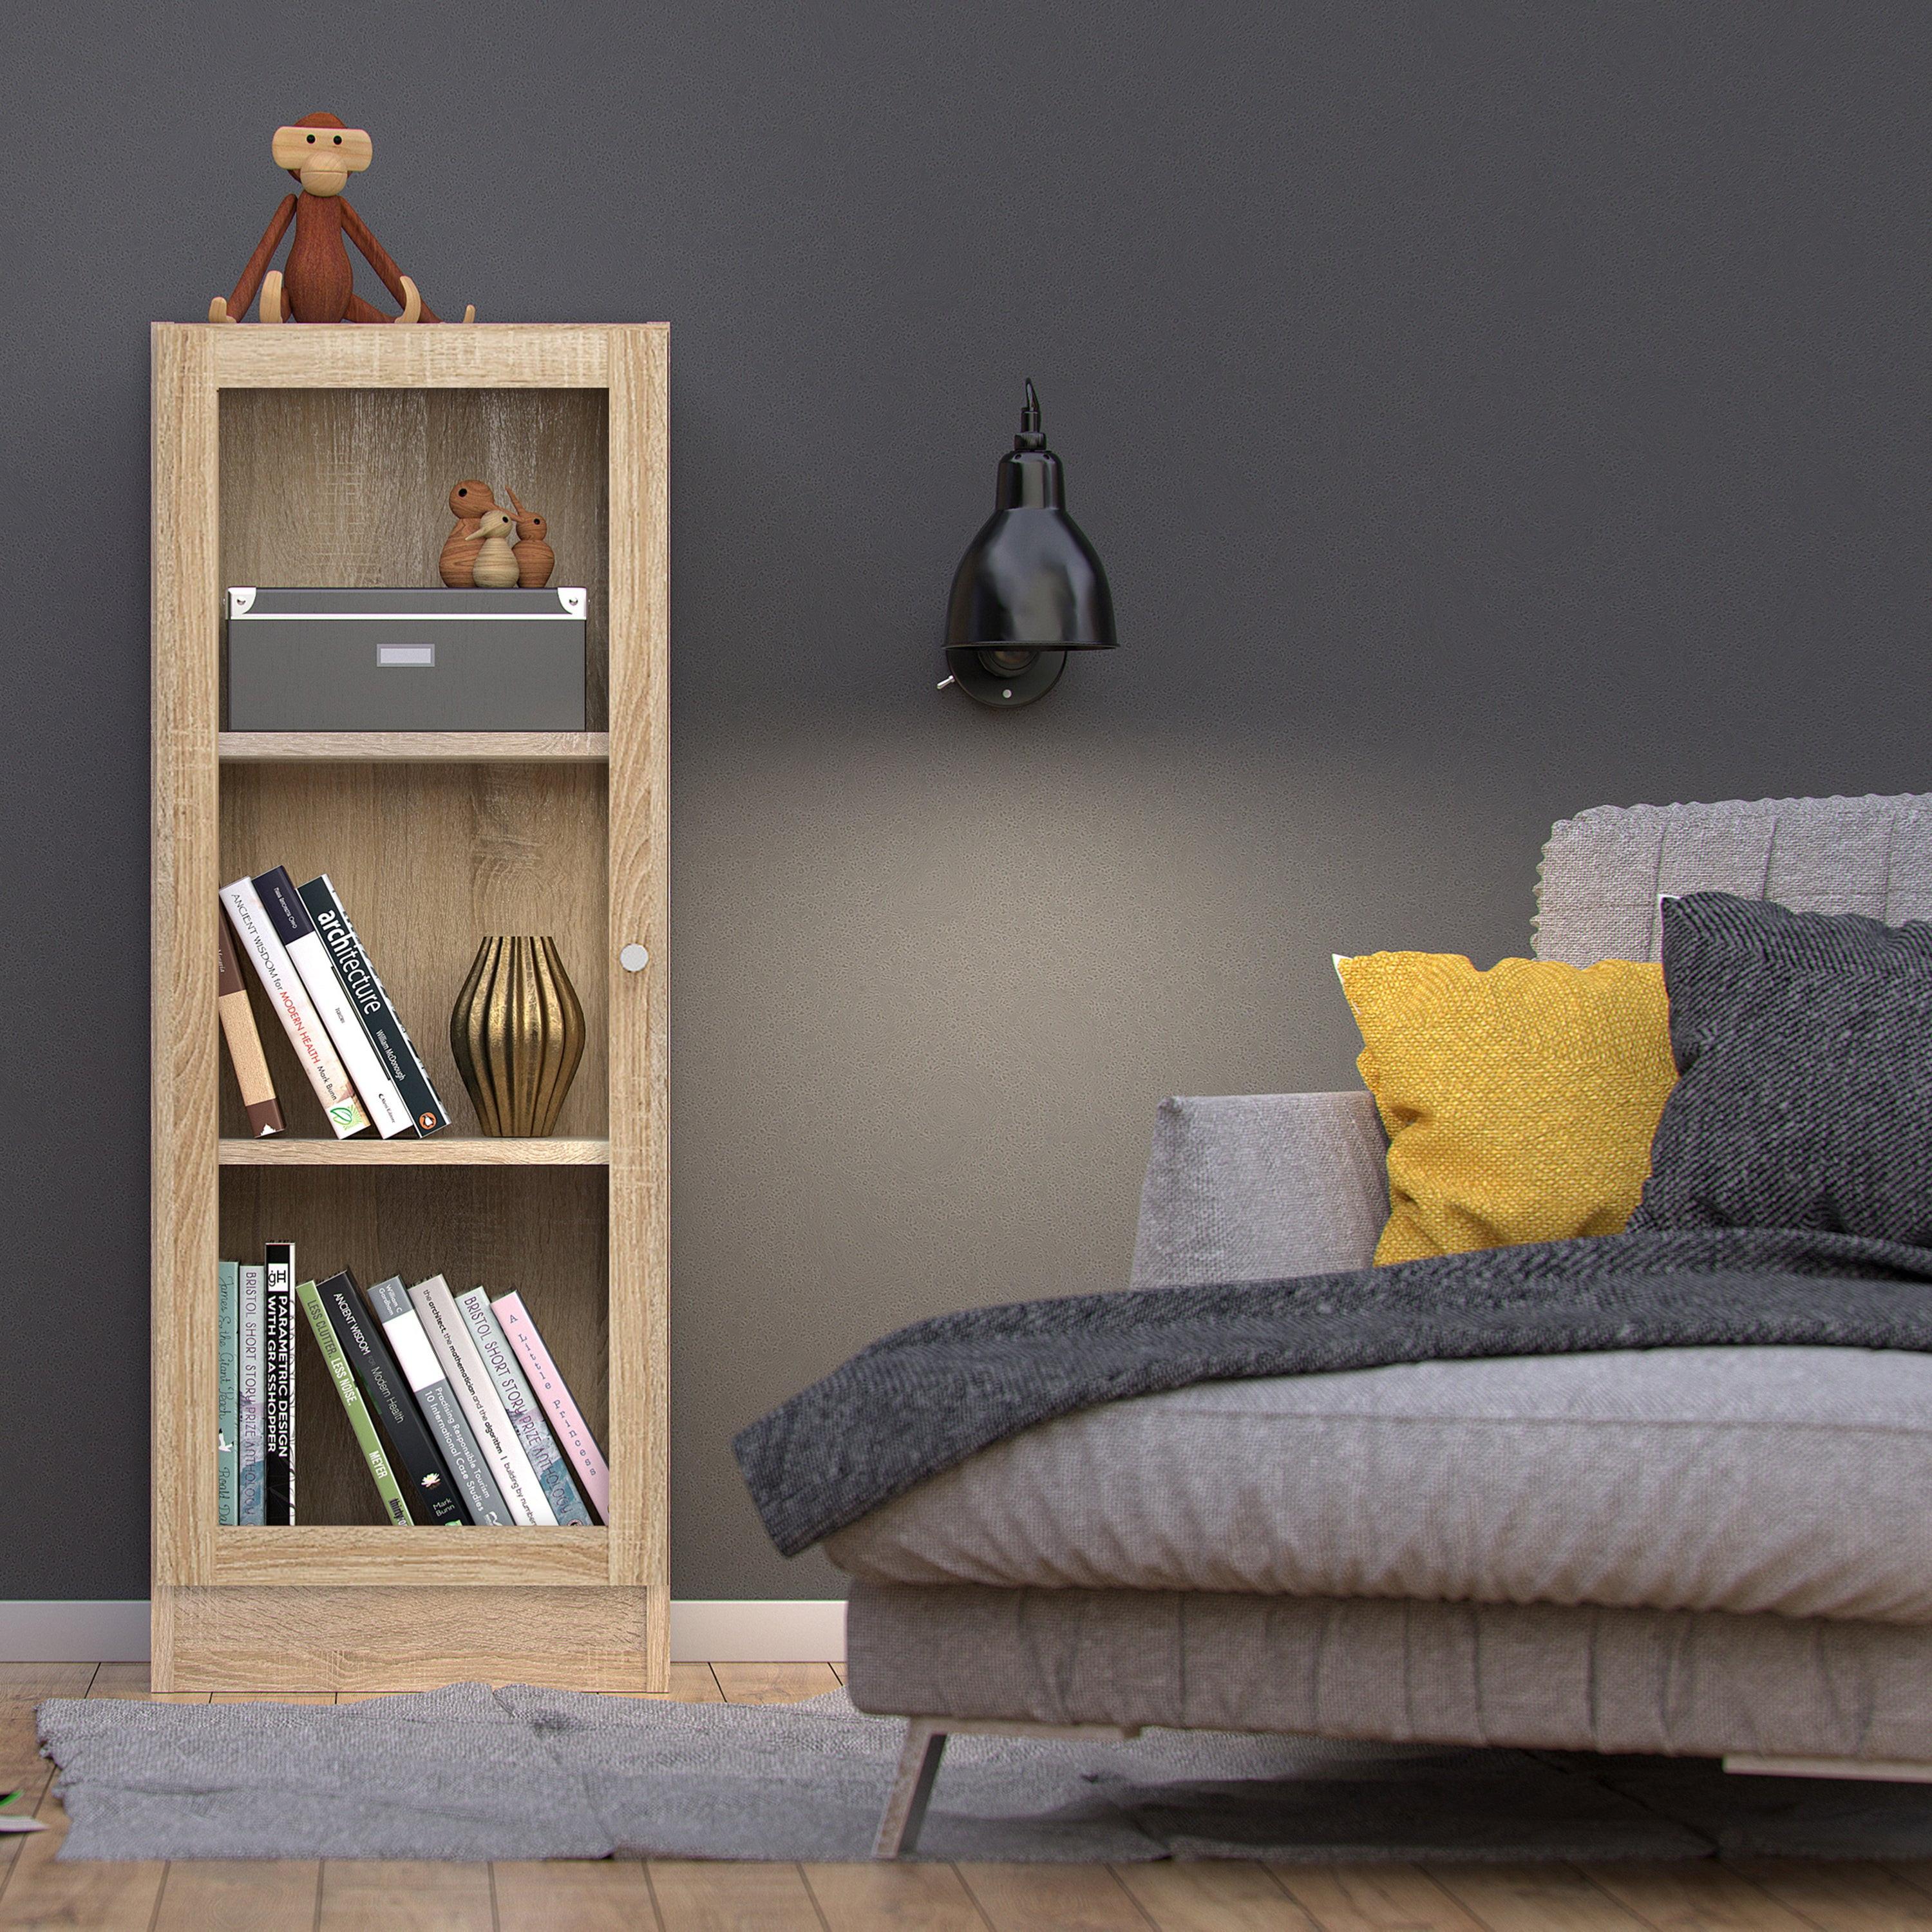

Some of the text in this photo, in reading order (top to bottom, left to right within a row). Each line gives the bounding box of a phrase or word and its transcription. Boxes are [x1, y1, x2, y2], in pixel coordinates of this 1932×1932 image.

[317, 909, 381, 1015] architecture
[231, 893, 337, 1101] ANCIENT WISDOM for MODERN HEALTH Mark Bunn
[375, 1029, 389, 1050] William
[386, 1048, 406, 1081] McDonough
[245, 1272, 256, 1318] BRISTOL
[379, 1288, 394, 1316] Gardham
[386, 1283, 399, 1307] William
[220, 1329, 231, 1347] the
[245, 1322, 256, 1360] SHORT
[307, 1300, 357, 1406] LESS CLUTTER. LESS NOISE.
[334, 1293, 404, 1424] ANCIENT WISDOM FOR Modern Health
[219, 1353, 234, 1383] Giant
[245, 1365, 256, 1405] STORY
[268, 1295, 276, 1452] WITH GRASSHOPPER
[278, 1296, 288, 1457] PARAMETRIC DESIGN
[219, 1387, 234, 1420] Peach
[423, 1289, 432, 1302] the
[428, 1301, 447, 1334] architect,
[444, 1333, 452, 1345] the
[449, 1345, 475, 1396] mathematician
[473, 1395, 482, 1410] and
[484, 1421, 503, 1454] algorithm
[504, 1463, 519, 1490] building
[516, 1486, 524, 1498] by
[464, 1296, 573, 1514] BRISTOL SHORT STORY PRIZE ANTHOLOGY
[510, 1314, 596, 1476] A Little Princess
[245, 1407, 256, 1437] PRIZE
[435, 1387, 455, 1424] Practising
[452, 1423, 475, 1469] Responsible
[474, 1468, 490, 1499] Tourism
[368, 1450, 388, 1479] MEYER
[424, 1390, 484, 1511] 10 International Case Studies
[219, 1467, 231, 1500] Roald
[244, 1441, 256, 1515] ANTHOLOGY
[433, 1498, 452, 1510] Mark
[435, 1504, 455, 1517] Bunn
